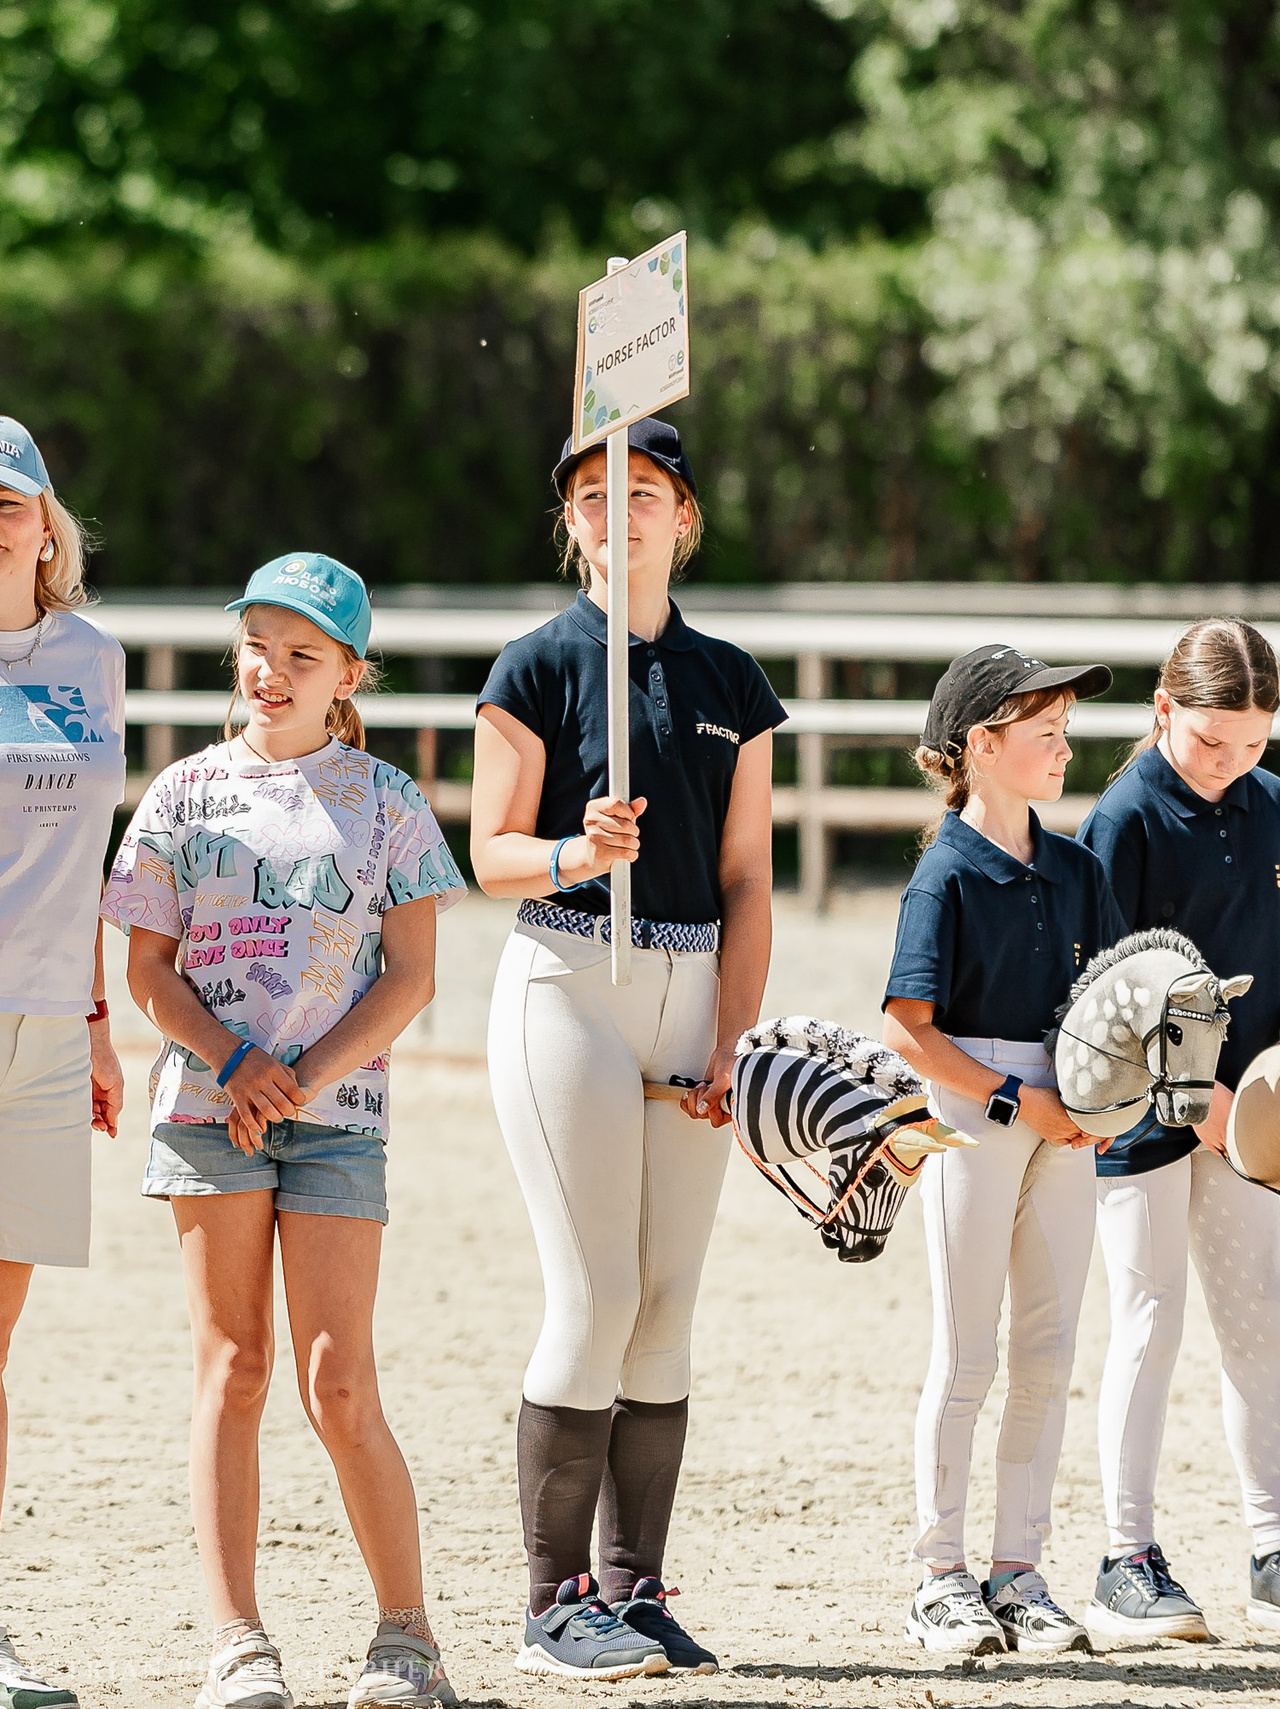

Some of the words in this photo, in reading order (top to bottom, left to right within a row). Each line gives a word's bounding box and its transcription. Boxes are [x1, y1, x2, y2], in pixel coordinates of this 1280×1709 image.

[596, 345, 633, 376] HORSE
[636, 317, 676, 355] FACTOR
[272, 575, 338, 606] ЛЮБОВЬ
[300, 573, 338, 595] ДАРЮ
[6, 753, 33, 763] FIRST
[35, 753, 91, 763] SWALLOWS
[24, 773, 78, 790] DANCE
[22, 805, 33, 813] LE
[34, 804, 78, 813] PRINTEMPS
[252, 853, 354, 915] BAD
[228, 915, 293, 936] ONLY
[231, 938, 289, 959] ONCE
